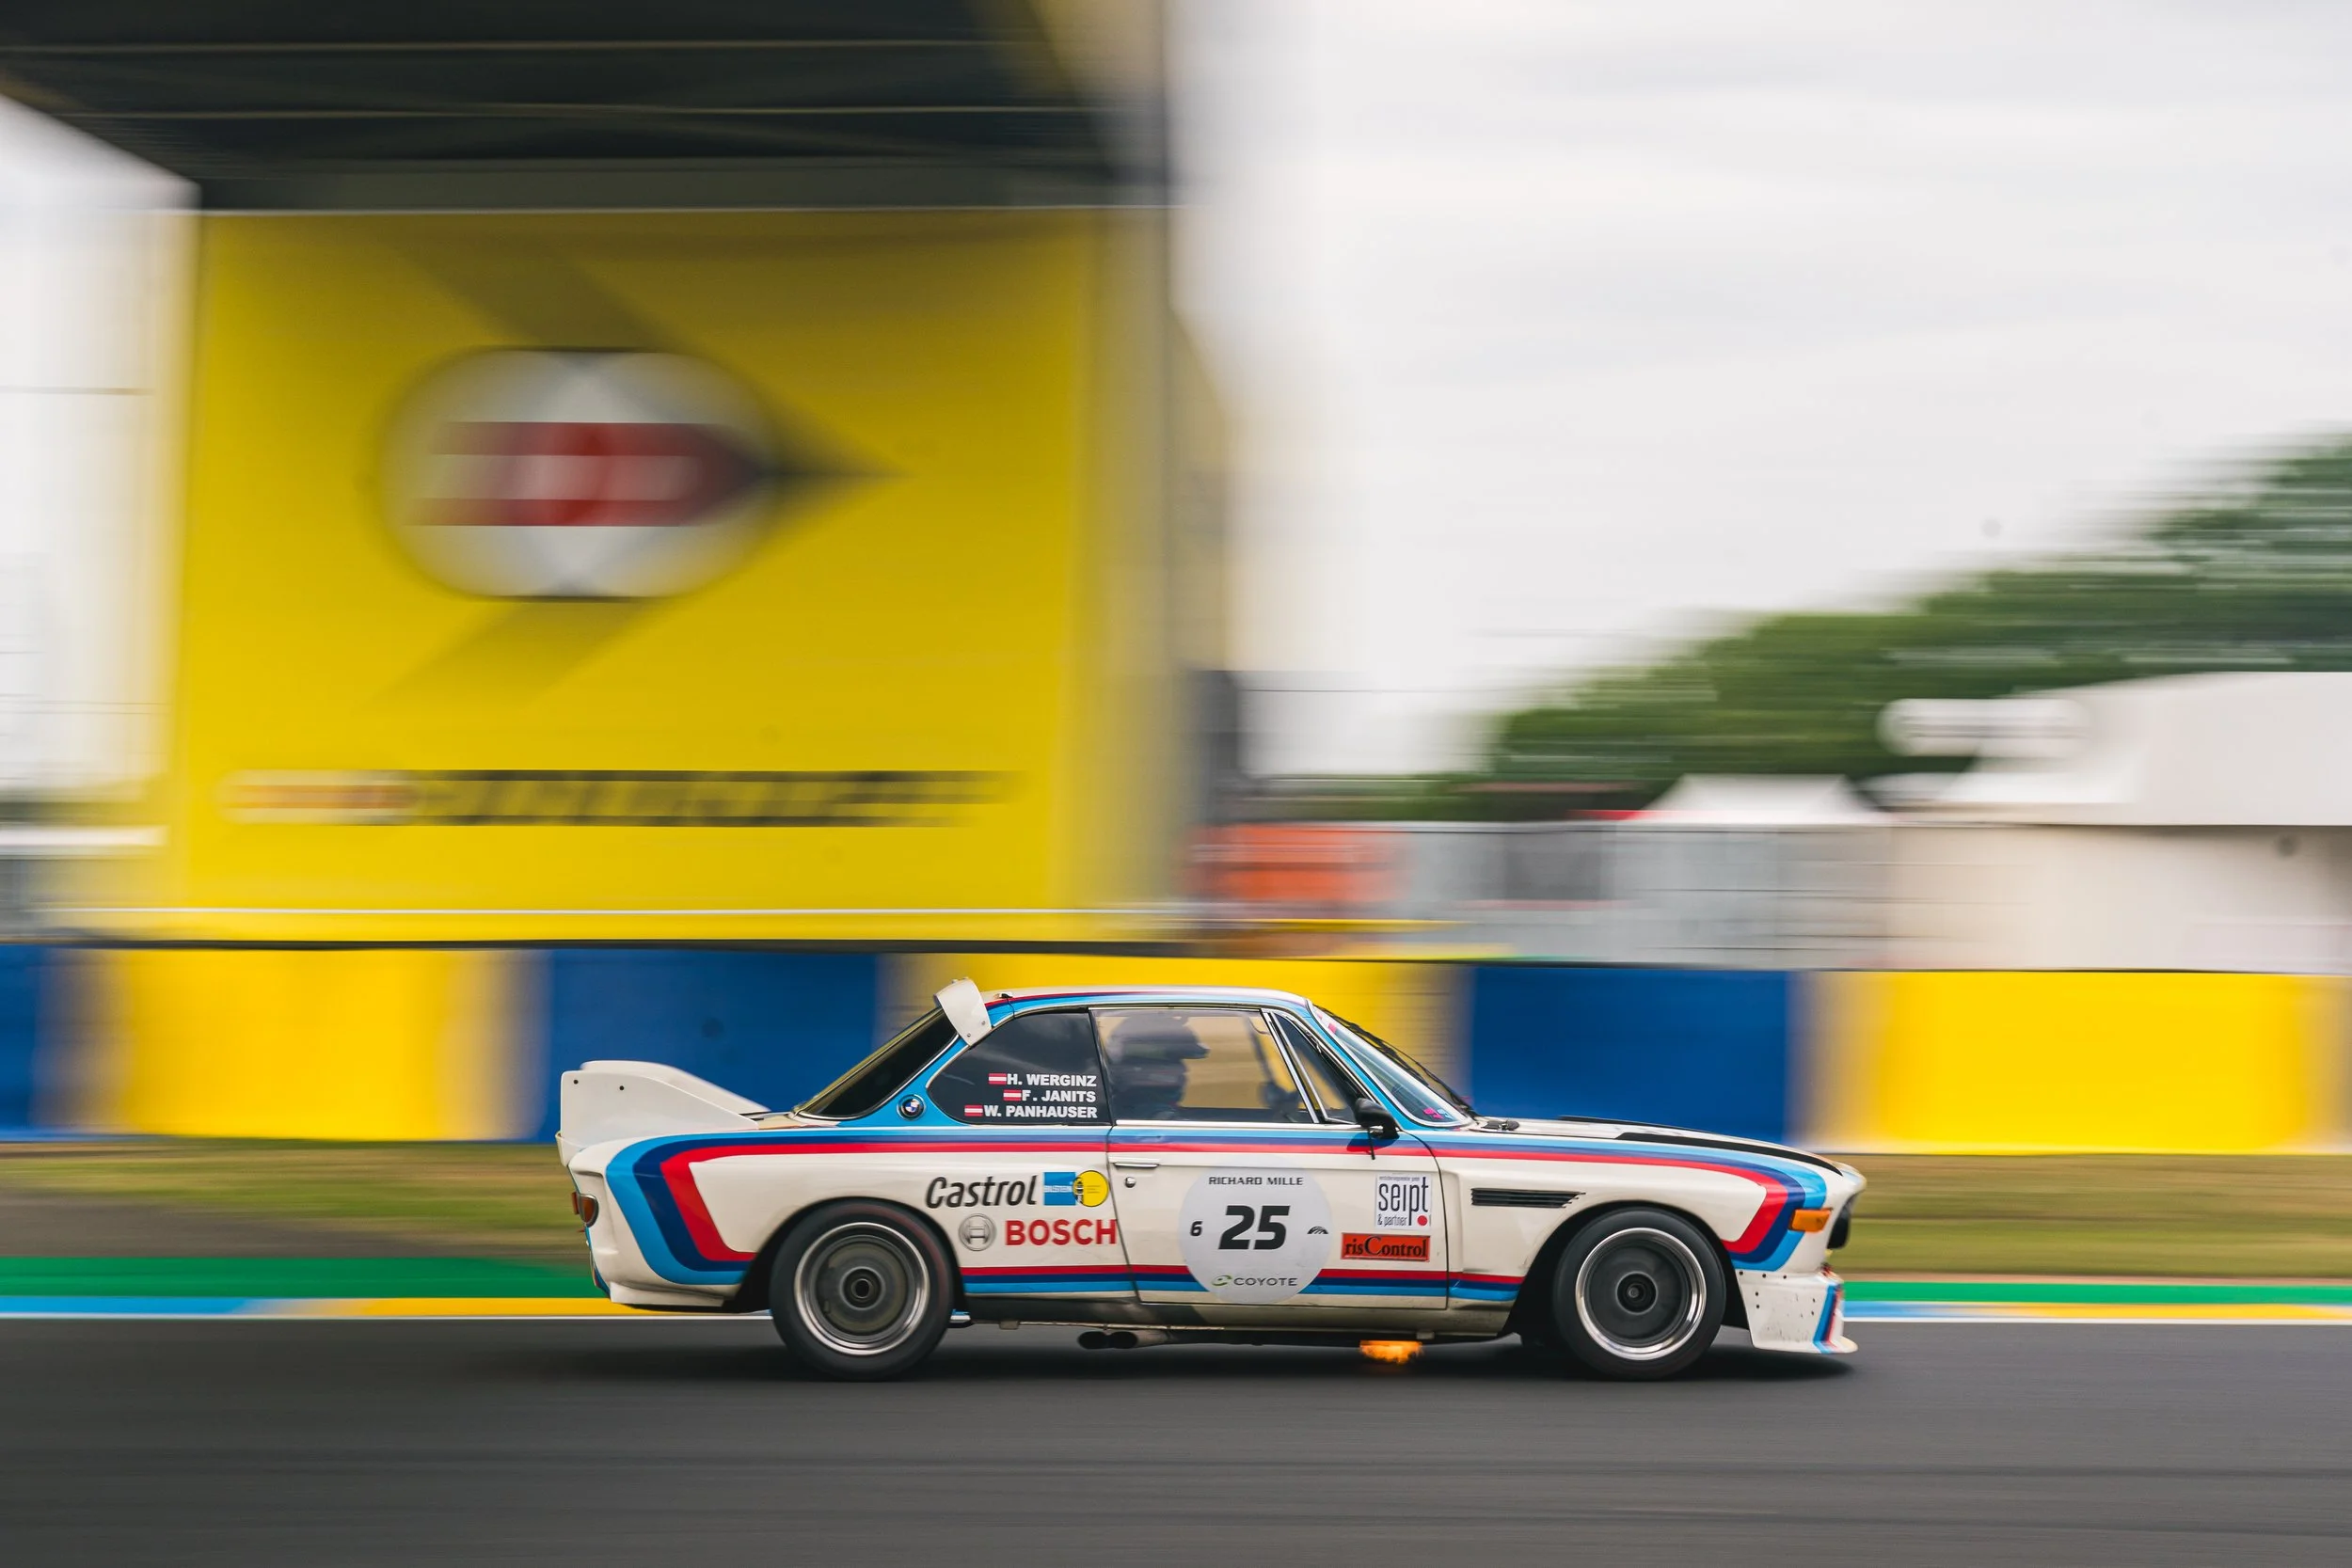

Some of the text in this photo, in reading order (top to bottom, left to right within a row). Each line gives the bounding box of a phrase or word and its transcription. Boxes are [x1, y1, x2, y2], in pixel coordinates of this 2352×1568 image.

[1007, 1073, 1097, 1087] H. WERGINZ
[1022, 1089, 1097, 1102] F. JANITS
[983, 1104, 1098, 1118] W. PANHAUSER
[1208, 1176, 1304, 1186] RICHARD MILLE
[926, 1175, 1039, 1209] Castrol
[1005, 1219, 1119, 1246] BOSCH
[1189, 1220, 1203, 1237] 6
[1217, 1205, 1291, 1250] 25
[1345, 1235, 1427, 1258] risControl
[1233, 1277, 1298, 1287] COYOTE
